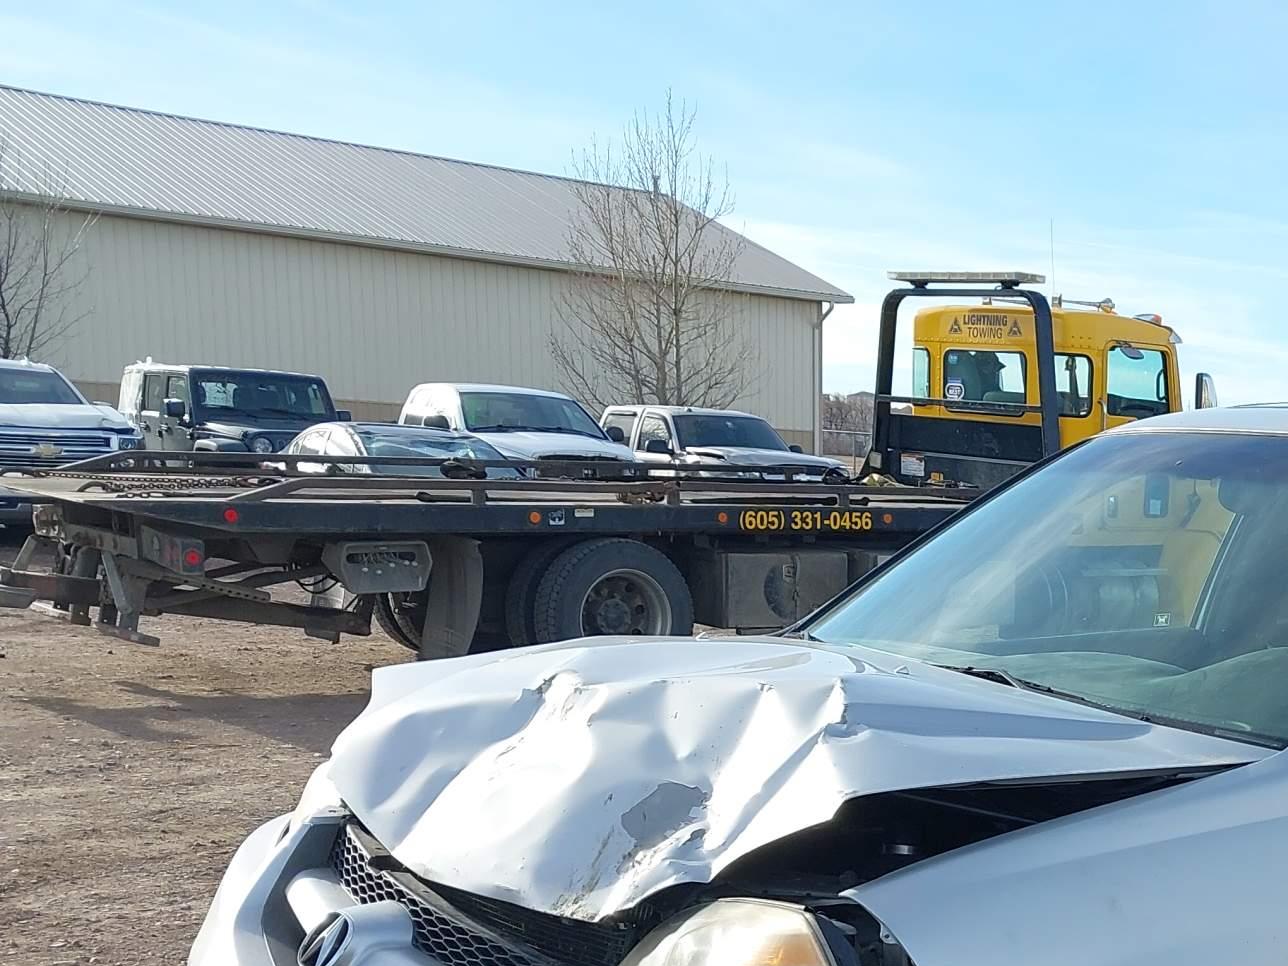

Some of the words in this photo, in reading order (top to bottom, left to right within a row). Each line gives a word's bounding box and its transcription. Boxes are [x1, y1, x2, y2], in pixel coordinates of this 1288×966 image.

[963, 314, 1008, 326] LIGHTNING
[968, 327, 1003, 339] TOWING
[739, 511, 785, 530] (605)
[791, 511, 872, 530] 331-0456
